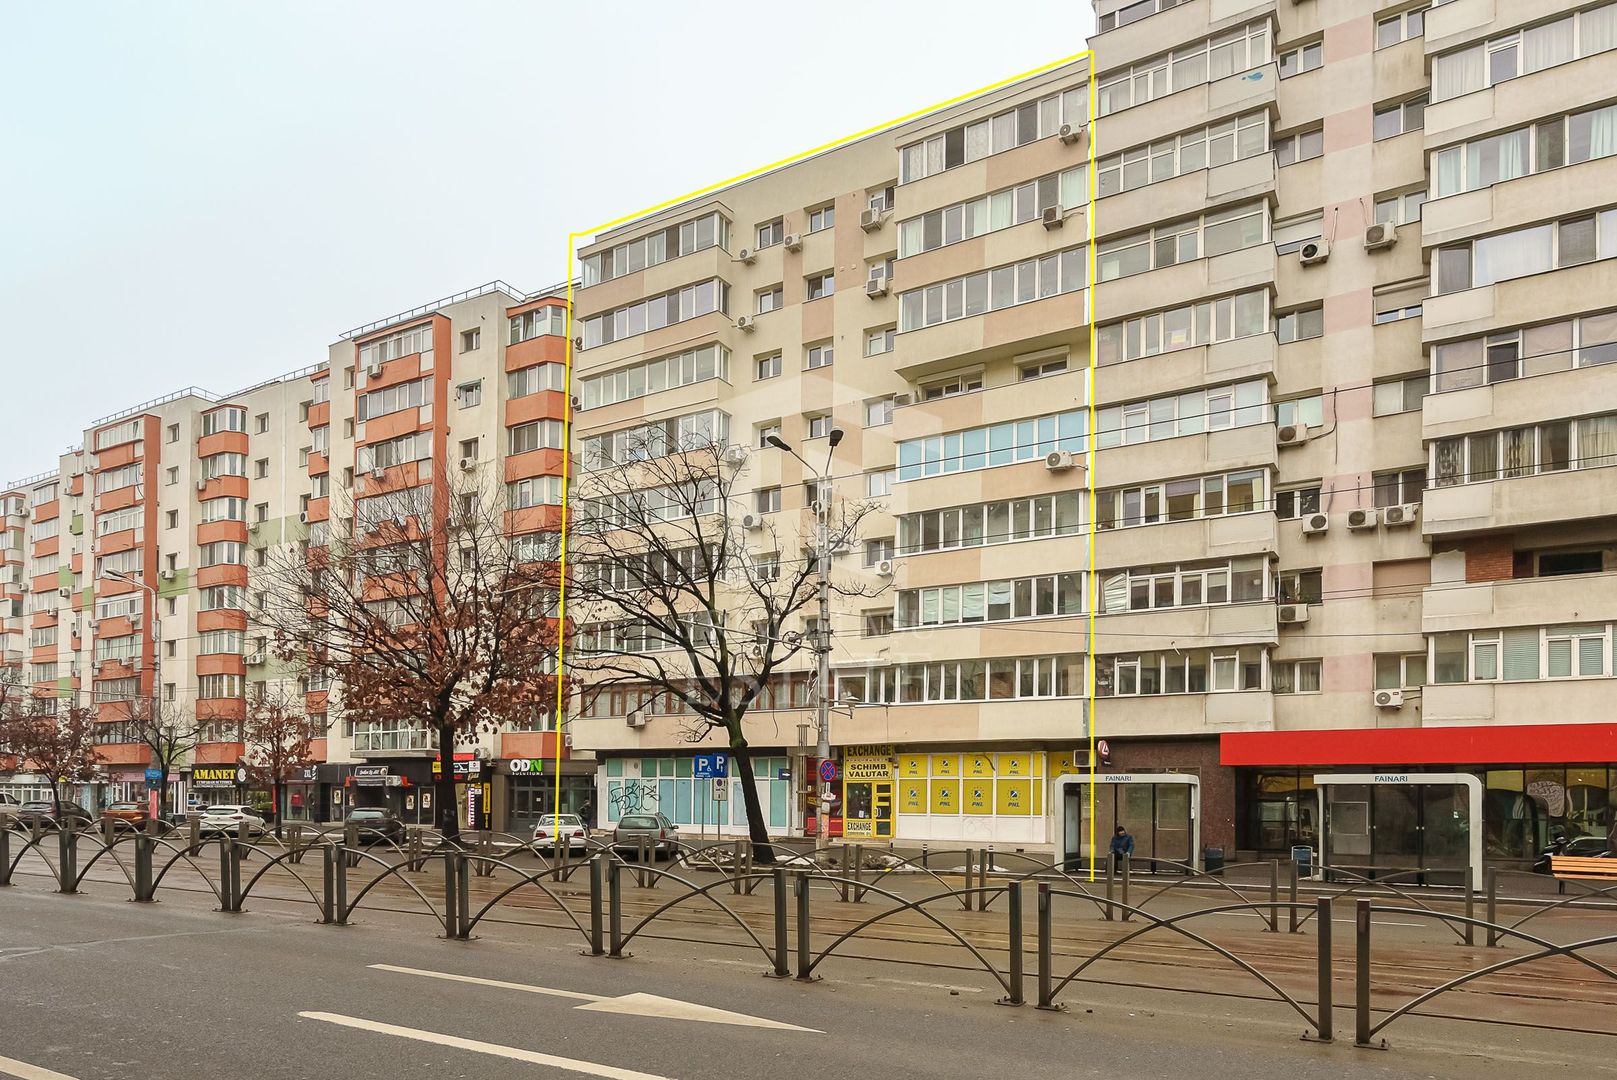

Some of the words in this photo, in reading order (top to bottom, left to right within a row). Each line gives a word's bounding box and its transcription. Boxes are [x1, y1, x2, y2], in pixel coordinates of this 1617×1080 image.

[847, 744, 891, 757] EXCHANGE
[510, 759, 543, 771] ODN
[698, 758, 709, 772] P
[716, 755, 725, 770] P
[193, 769, 236, 780] AMANET
[848, 770, 889, 778] VALUTAR
[847, 822, 871, 831] EXCHANGE
